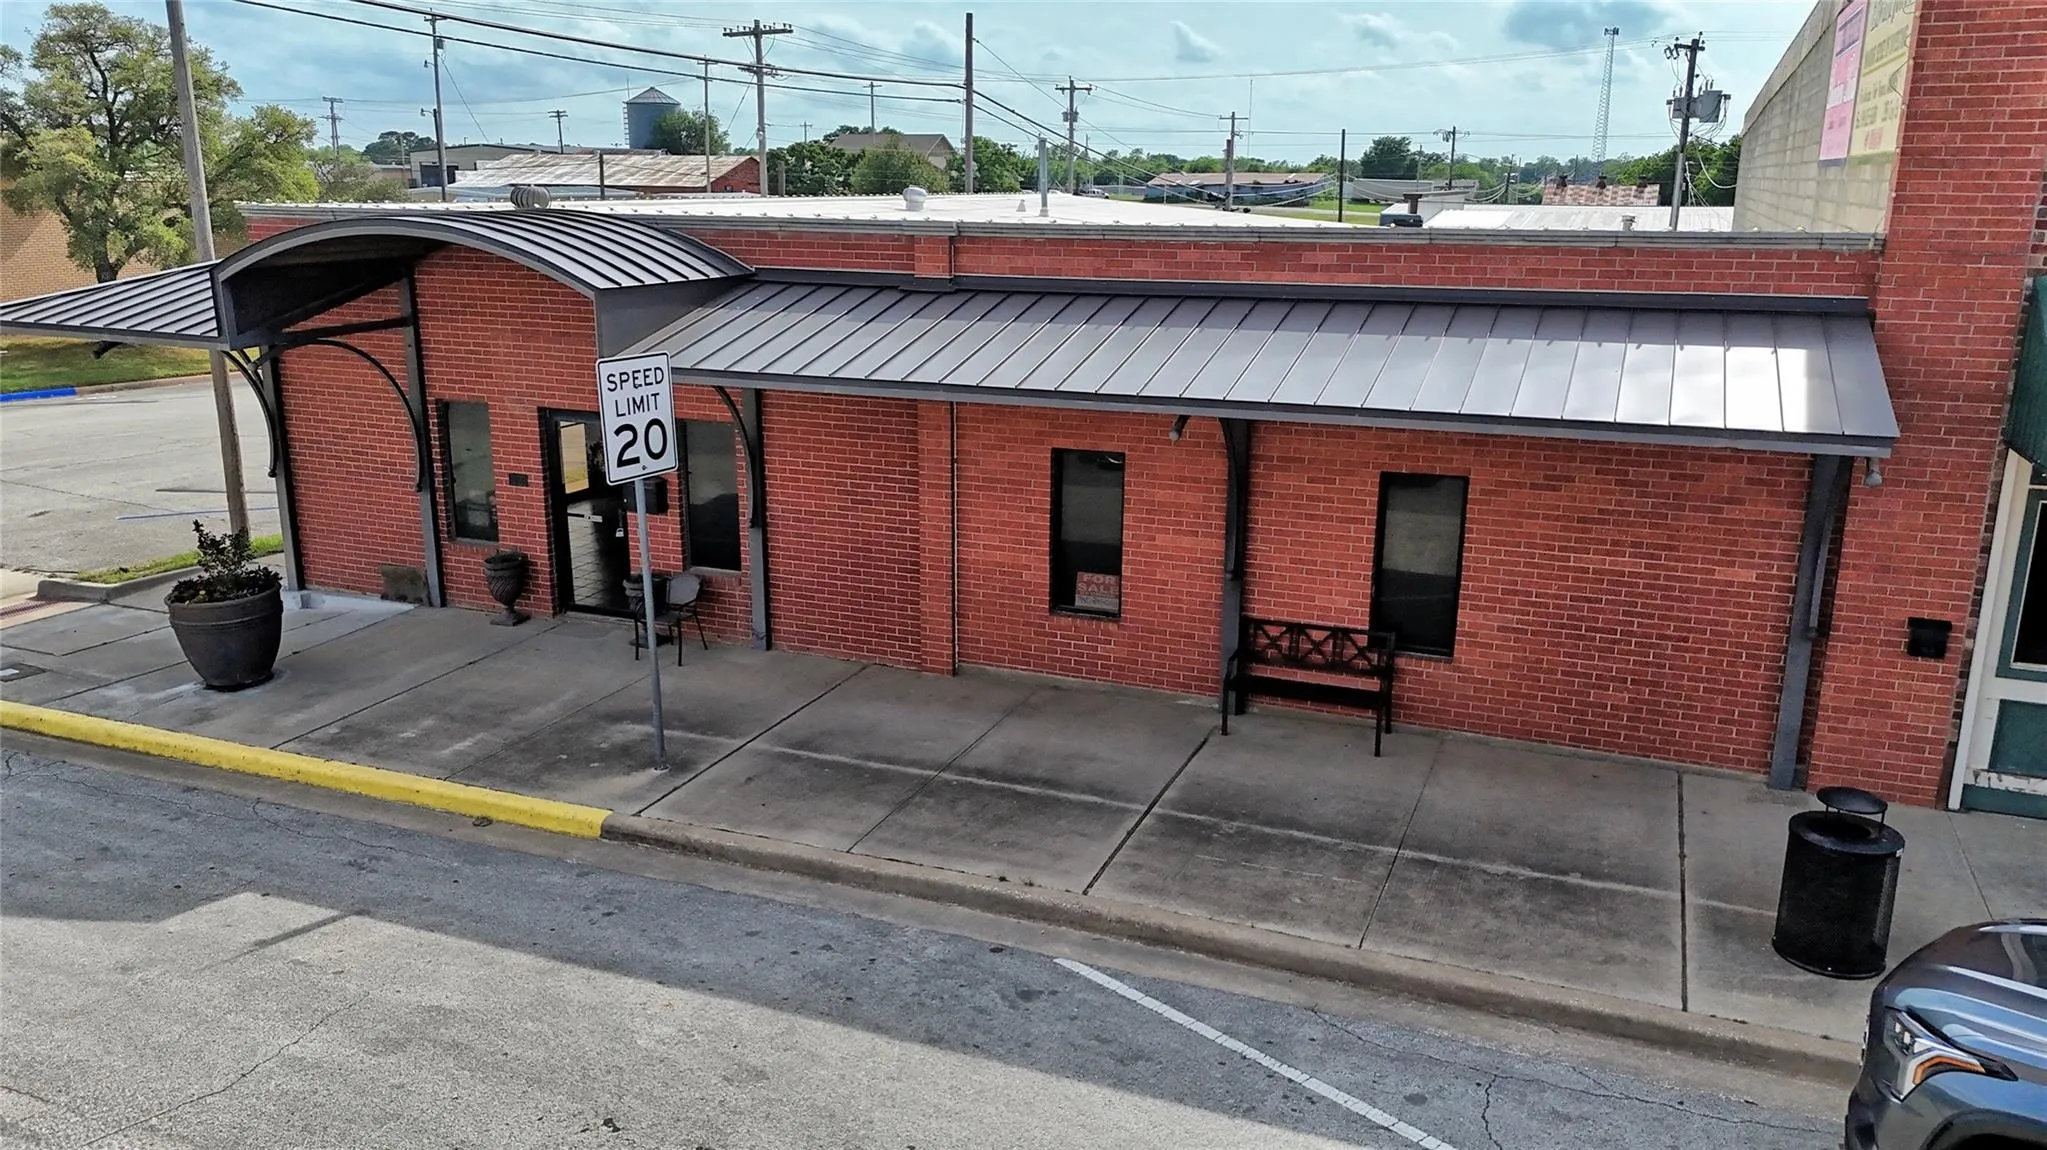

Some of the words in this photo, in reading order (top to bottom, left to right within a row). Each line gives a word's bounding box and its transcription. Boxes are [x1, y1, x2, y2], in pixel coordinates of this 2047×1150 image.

[606, 366, 665, 392] SPEED
[614, 392, 660, 418] LIMIT
[613, 417, 668, 469] 20
[1077, 582, 1120, 595] SALE
[1083, 573, 1116, 585] FOR
